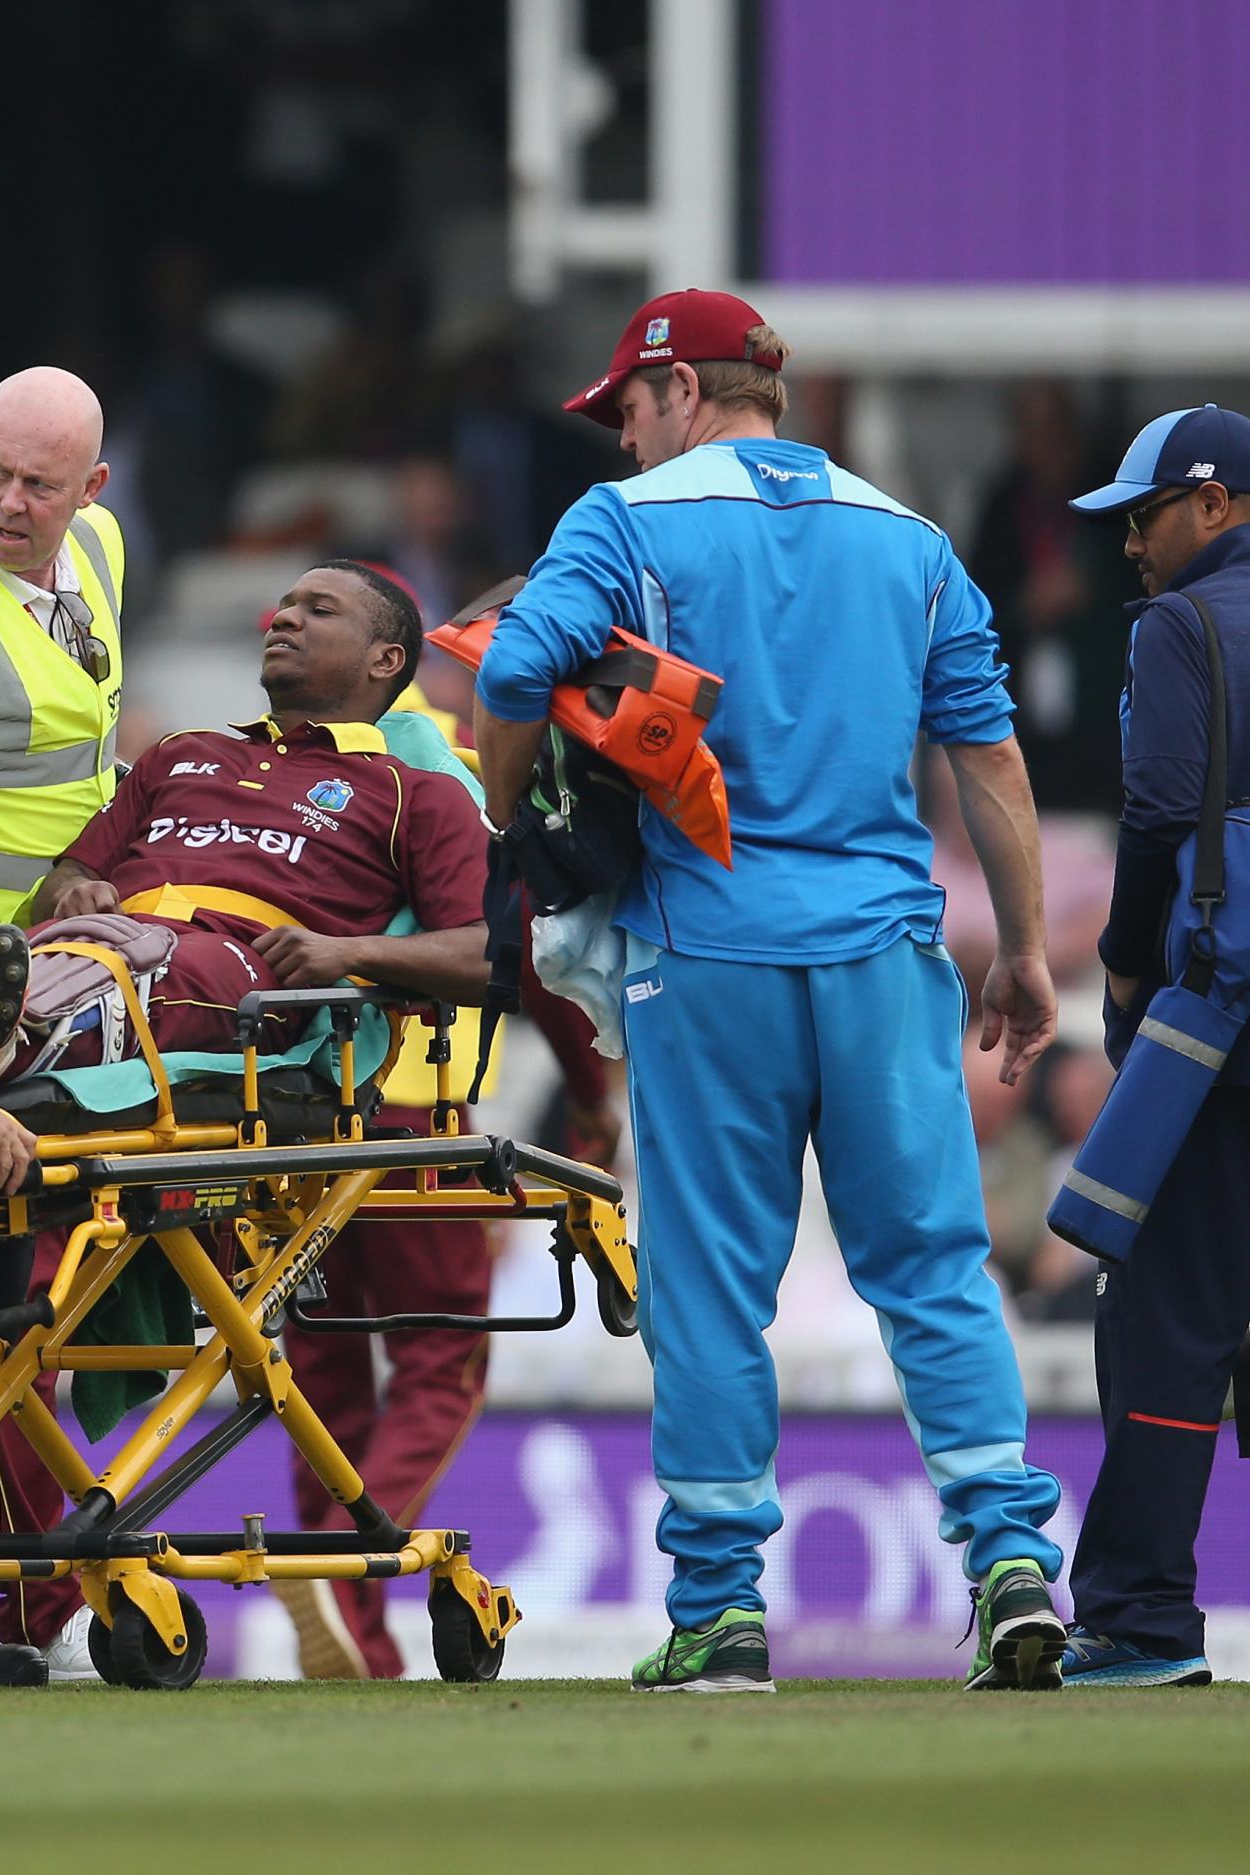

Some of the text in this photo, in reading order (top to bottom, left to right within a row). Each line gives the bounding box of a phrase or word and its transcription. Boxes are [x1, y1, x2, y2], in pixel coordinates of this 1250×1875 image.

[639, 347, 674, 360] WINDIES
[169, 761, 222, 777] BLK
[292, 801, 340, 832] WINDIES
[301, 815, 324, 833] 174
[147, 817, 307, 864] Digicel
